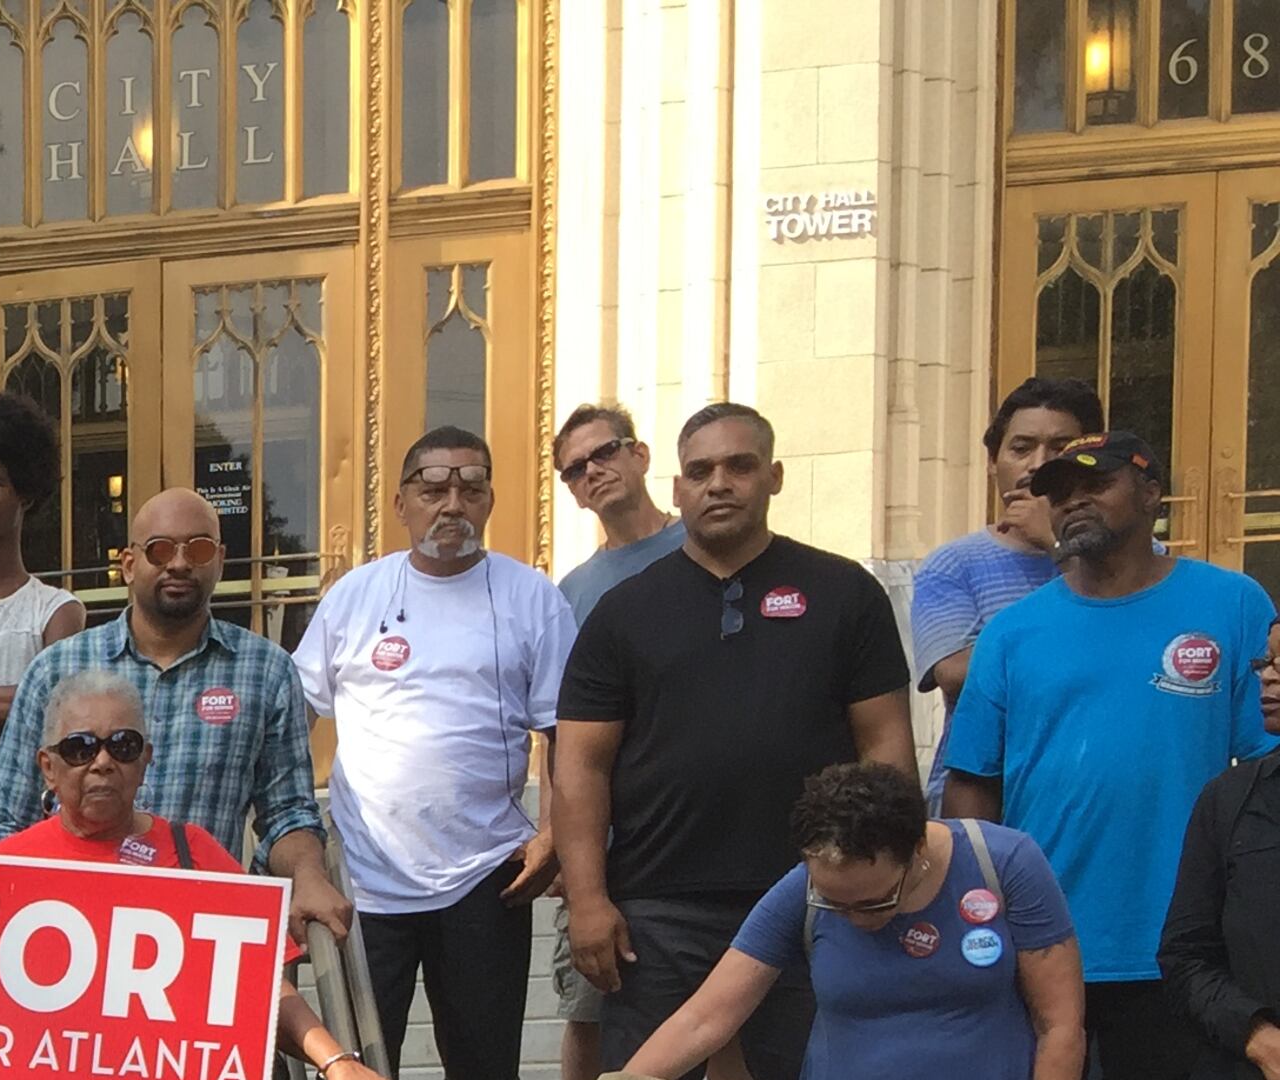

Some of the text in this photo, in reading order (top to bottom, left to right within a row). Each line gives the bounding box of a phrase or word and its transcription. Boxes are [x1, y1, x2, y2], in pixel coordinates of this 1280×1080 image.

[1168, 32, 1270, 85] 68
[47, 62, 279, 122] CITY
[46, 125, 275, 182] HALL
[765, 189, 877, 214] CITY HALL
[765, 208, 874, 242] TOWER
[208, 461, 243, 473] ENTER
[212, 499, 243, 508] MOKING
[765, 592, 800, 607] FORT
[379, 641, 409, 654] FORT
[1177, 646, 1213, 658] FORT
[201, 694, 234, 706] FORT
[121, 838, 157, 857] FORT
[906, 928, 937, 945] FORT
